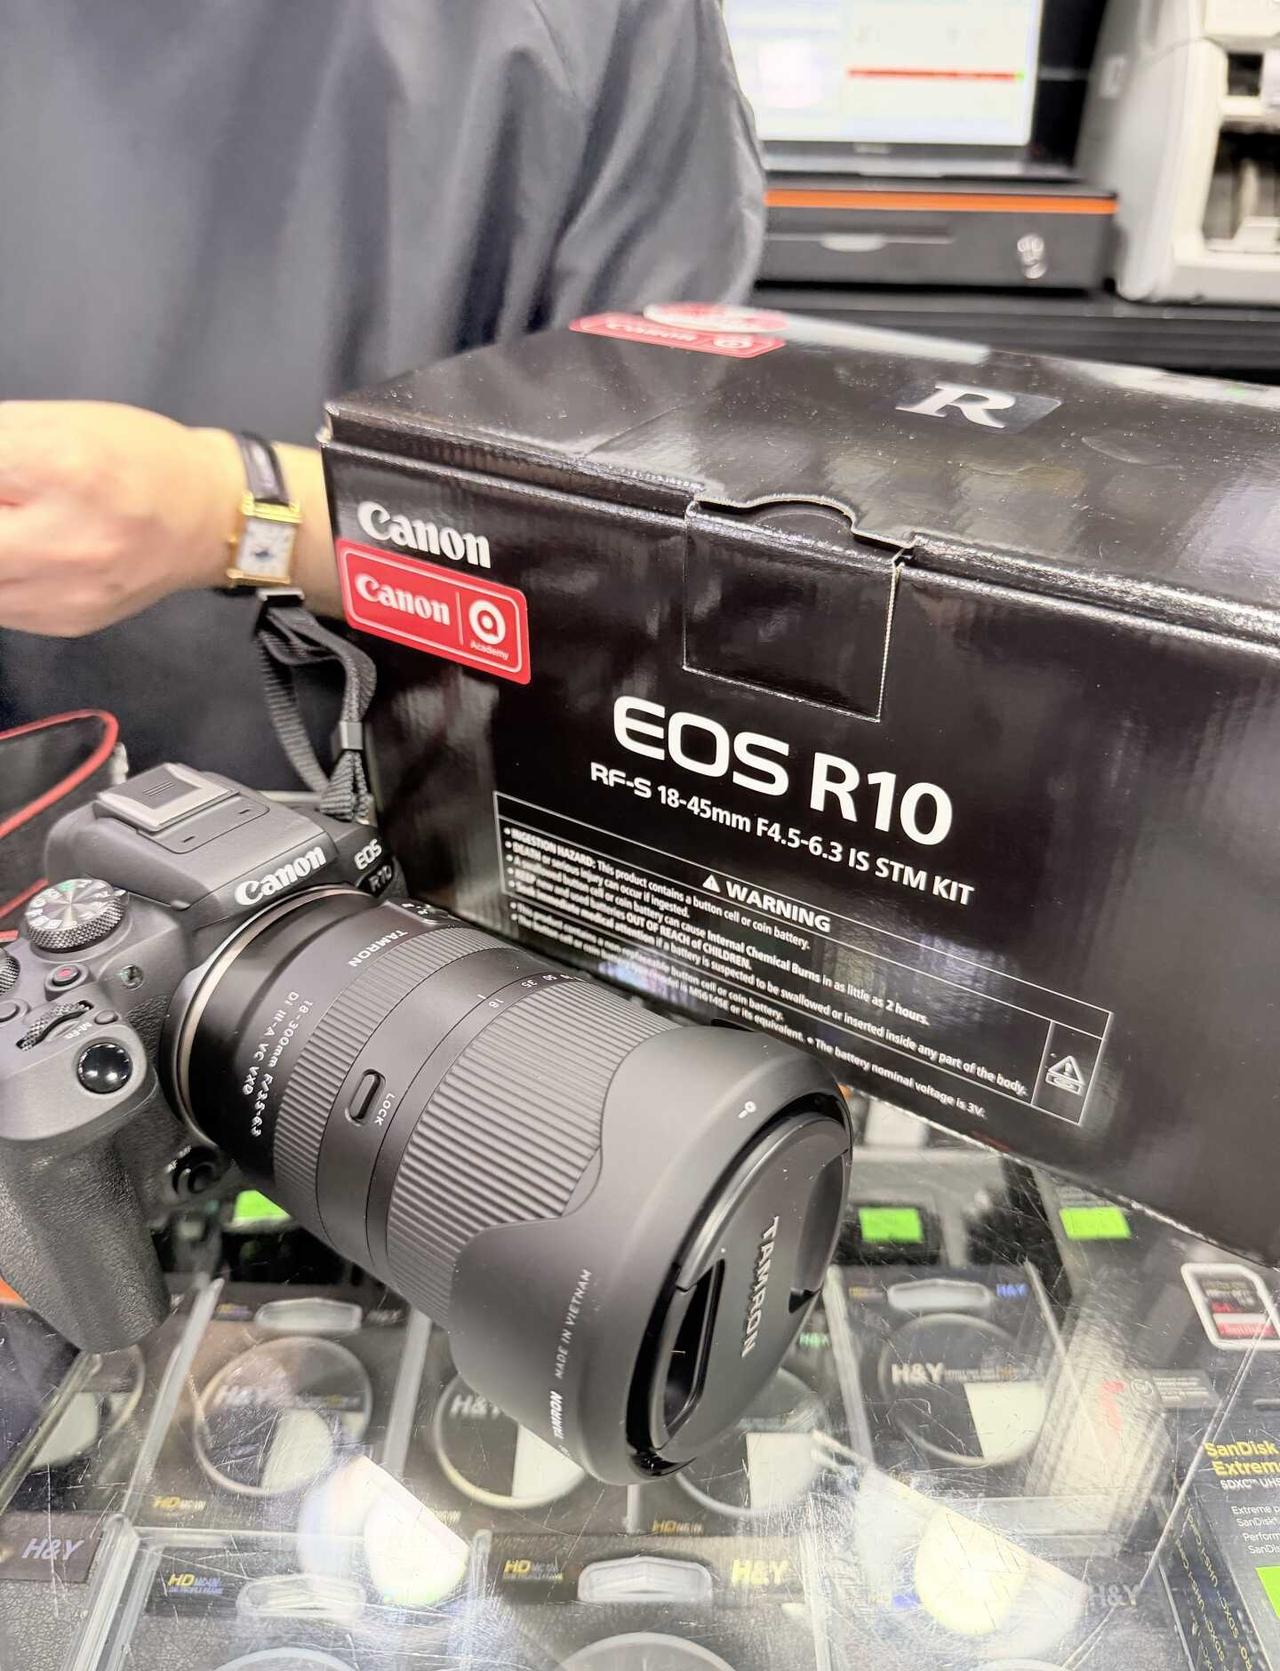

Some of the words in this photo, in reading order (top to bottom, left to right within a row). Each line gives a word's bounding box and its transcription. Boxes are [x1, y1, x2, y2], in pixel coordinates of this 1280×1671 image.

[896, 382, 1017, 428] R
[357, 501, 491, 568] Canon
[354, 573, 450, 626] Canon
[613, 695, 791, 797] EOS
[809, 751, 953, 846] R10
[354, 838, 382, 870] EOS
[590, 762, 652, 799] RF-S
[657, 784, 752, 833] 18-45mm
[755, 817, 843, 863] F4.5-6.3
[848, 848, 870, 873] IS
[875, 858, 928, 892] STM
[933, 877, 975, 906] KIT
[234, 846, 327, 906] Canon
[604, 878, 619, 892] can
[620, 884, 641, 900] occur
[643, 890, 650, 904] if
[651, 893, 690, 921] ingested.
[597, 859, 613, 876] This
[615, 866, 646, 890] product
[648, 878, 683, 902] contains
[685, 895, 691, 905] a
[693, 895, 721, 916] button
[724, 906, 739, 923] cell
[740, 915, 751, 928] or
[752, 917, 772, 935] coin
[773, 925, 810, 952] battery.
[725, 880, 831, 933] WARNING
[349, 930, 408, 967] TAMRON
[589, 884, 604, 899] cell
[605, 892, 613, 903] or
[615, 893, 631, 910] coin
[633, 901, 663, 924] battery
[664, 915, 679, 929] can
[681, 921, 705, 938] cause
[707, 929, 744, 954] Internal
[745, 944, 790, 971] Chemical
[791, 962, 821, 983] Burns
[822, 974, 832, 988] in
[833, 980, 845, 993] as
[847, 983, 869, 1002] little
[871, 995, 883, 1007] as
[885, 998, 895, 1012] 2
[894, 1002, 931, 1026] hours.
[626, 911, 644, 928] OUT
[646, 918, 658, 934] OF
[660, 924, 690, 946] REACH
[691, 936, 701, 951] of
[702, 940, 752, 971] CHILDREN.
[670, 942, 701, 966] battery
[702, 954, 709, 968] is
[711, 958, 754, 987] suspected
[755, 976, 765, 990] to
[767, 980, 779, 996] be
[780, 986, 830, 1016] swallowed
[831, 1008, 842, 1021] or
[843, 1011, 884, 1037] inserted
[885, 1027, 917, 1050] inside
[917, 1043, 938, 1061] any
[938, 1049, 962, 1070] part
[962, 1058, 976, 1074] of
[976, 1064, 996, 1082] the
[995, 1072, 1029, 1097] body.
[700, 977, 716, 993] cell
[717, 986, 726, 997] or
[728, 988, 747, 1005] coin
[748, 996, 784, 1022] battery.
[267, 999, 313, 1068] 18-300mm
[754, 1012, 804, 1043] equivalent.
[253, 1043, 269, 1061] VC
[243, 1066, 259, 1095] VXD
[815, 1038, 838, 1056] The
[839, 1048, 870, 1071] battery
[871, 1062, 914, 1088] nominal
[914, 1079, 955, 1107] voltage
[956, 1097, 967, 1109] is
[966, 1101, 986, 1117] 3V.
[374, 1092, 396, 1127] LOCK
[564, 1269, 593, 1327] VIETNAM
[741, 1215, 780, 1359] TAMRON
[561, 1328, 573, 1344] IN
[554, 1345, 569, 1380] MADE
[891, 1362, 945, 1385] H&Y
[550, 1390, 564, 1439] TAMRON
[1204, 1441, 1280, 1458] SanDisk
[1212, 1461, 1280, 1477] Extrem
[21, 1538, 85, 1561] H&Y
